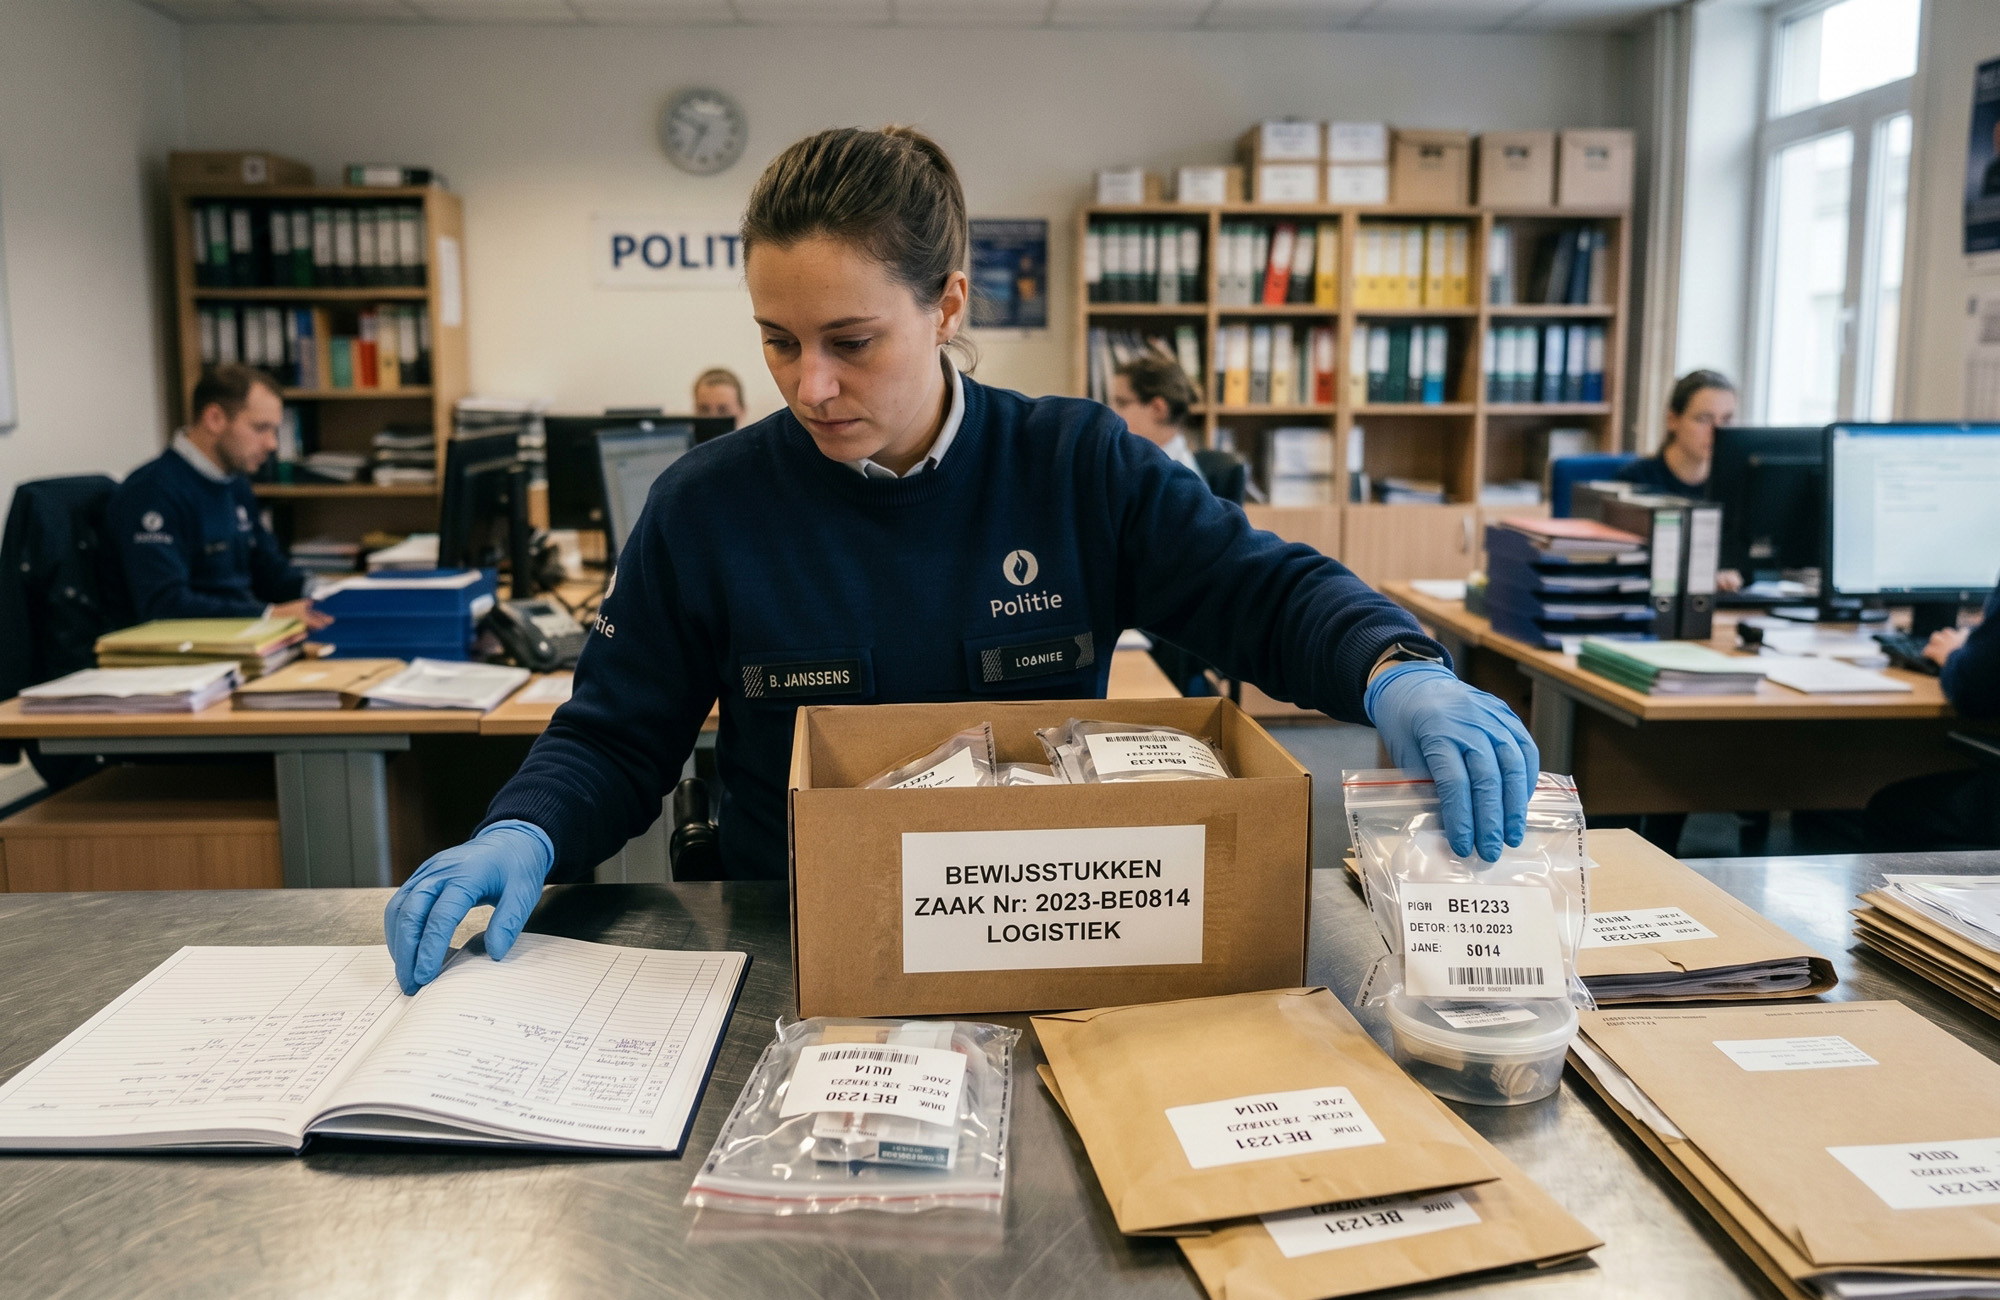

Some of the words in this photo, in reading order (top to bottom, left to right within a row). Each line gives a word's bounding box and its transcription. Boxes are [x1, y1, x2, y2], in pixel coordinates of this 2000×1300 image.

[990, 590, 1063, 618] Politie
[769, 674, 781, 688] B.
[783, 669, 851, 688] JANSSENS
[945, 859, 1162, 885] BEWIJSSTUKKEN
[914, 896, 986, 916] ZAAK
[993, 894, 1027, 914] Nr:
[1035, 888, 1191, 912] 2023-BE0814
[1448, 898, 1511, 914] BE1233
[987, 920, 1122, 943] LOGISTIEK
[1409, 922, 1450, 933] DETOR:
[1453, 923, 1513, 935] 13.10.2023
[1410, 943, 1442, 953] JANE:
[825, 1091, 899, 1105] BE1230
[1235, 1130, 1314, 1151] BE1231
[1324, 1209, 1406, 1236] BE1231
